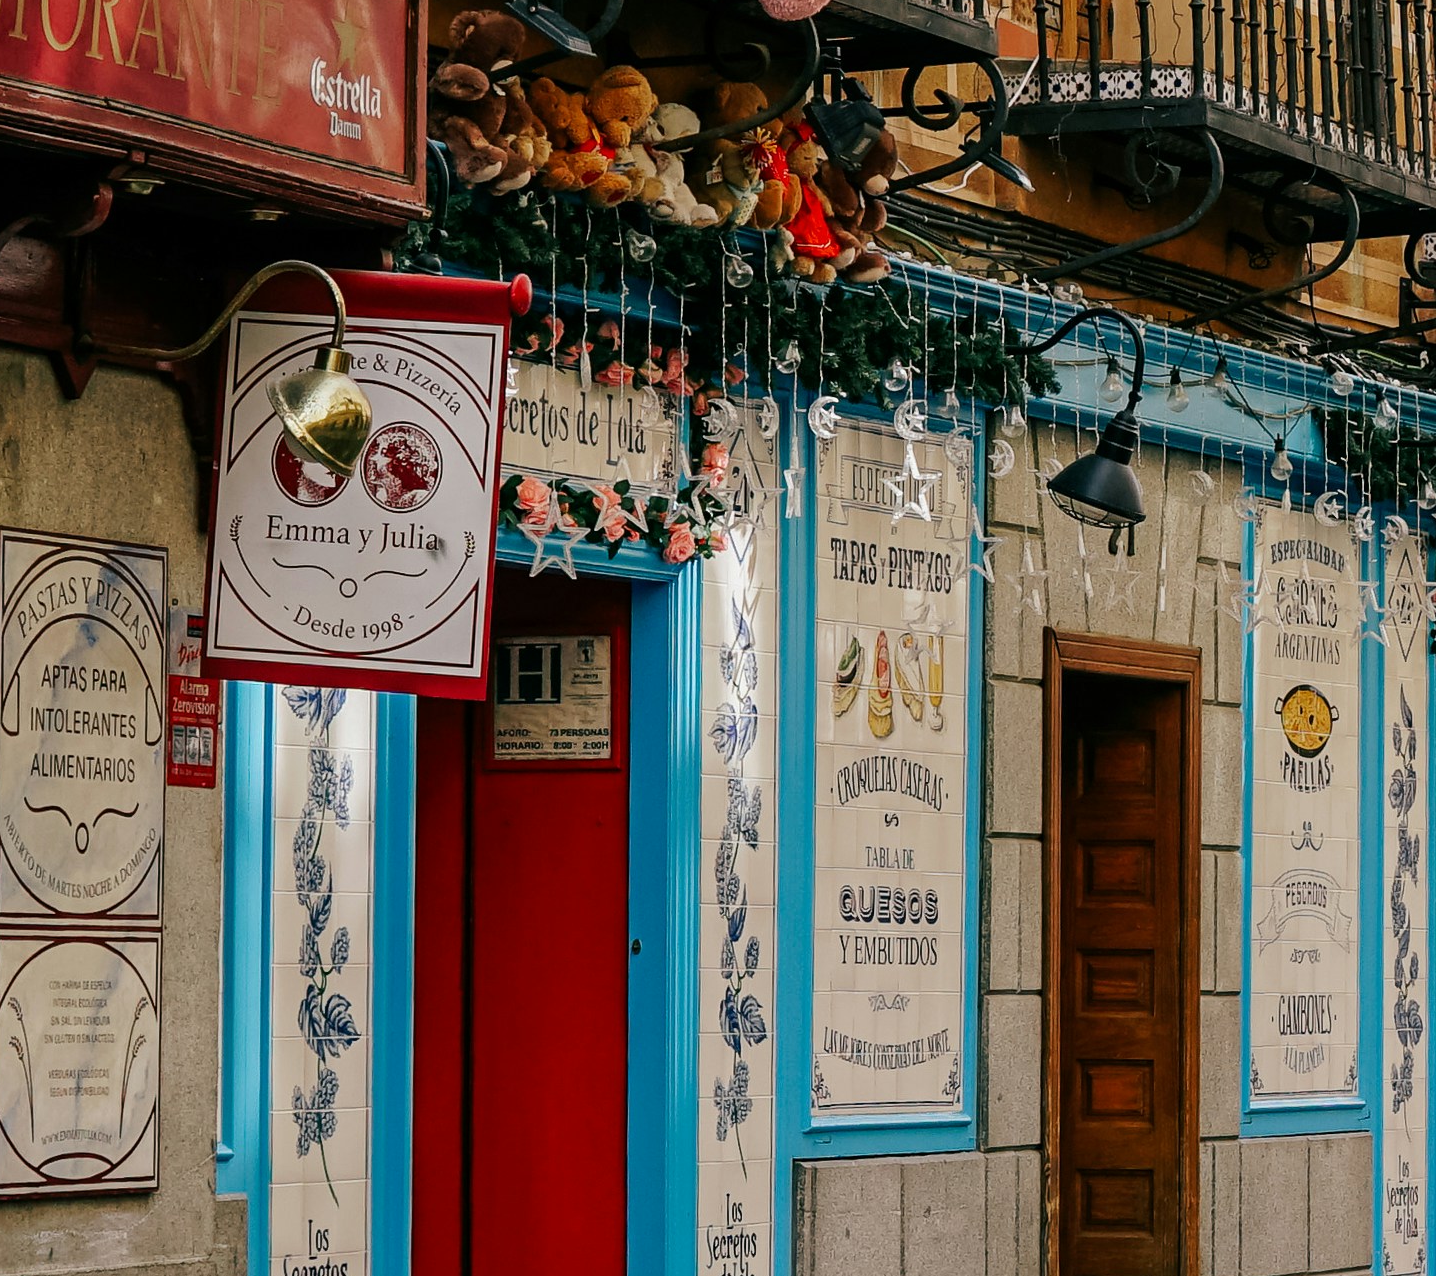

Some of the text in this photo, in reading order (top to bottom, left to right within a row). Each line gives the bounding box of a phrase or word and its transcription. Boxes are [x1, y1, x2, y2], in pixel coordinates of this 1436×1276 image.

[310, 56, 381, 119] Estrella
[330, 111, 362, 141] Damm
[394, 357, 463, 416] Pizzería
[576, 393, 599, 446] de
[605, 393, 647, 467] Lola
[265, 514, 441, 554] Emma y Julia
[830, 538, 952, 594] TAPAS Y PINTXOS
[17, 576, 151, 651] PASTAS Y PIZZAS
[293, 604, 404, 640] Desde 1998
[1274, 632, 1340, 666] ARGENTINAS
[41, 665, 127, 694] APTAS PARA
[180, 678, 209, 697] Alarma
[505, 645, 558, 701] H
[30, 707, 136, 739] INTOLERANTES
[561, 727, 609, 737] PERSONAS
[30, 753, 136, 783] ALIMENTARIOS
[837, 755, 943, 812] CROQUETAS CASERAS
[4, 814, 35, 871] ABIERTO
[34, 864, 48, 885] DE
[47, 874, 82, 899] MARTES
[82, 877, 113, 899] NOCHE
[119, 828, 156, 883] DOMINGO
[865, 846, 915, 870] TABLA DE
[839, 884, 939, 924] QUESOS
[1285, 882, 1328, 909] PESCADOS
[839, 935, 938, 966] Y EMBUTIDOS
[1277, 994, 1333, 1036] GAMBONES
[823, 1026, 839, 1055] LAS
[1398, 1154, 1410, 1183] Los
[726, 1193, 743, 1230] Los
[1387, 1179, 1419, 1217] Secretos
[308, 1219, 330, 1260] Los
[1394, 1207, 1419, 1245] de Lola
[706, 1224, 758, 1273] Secretos
